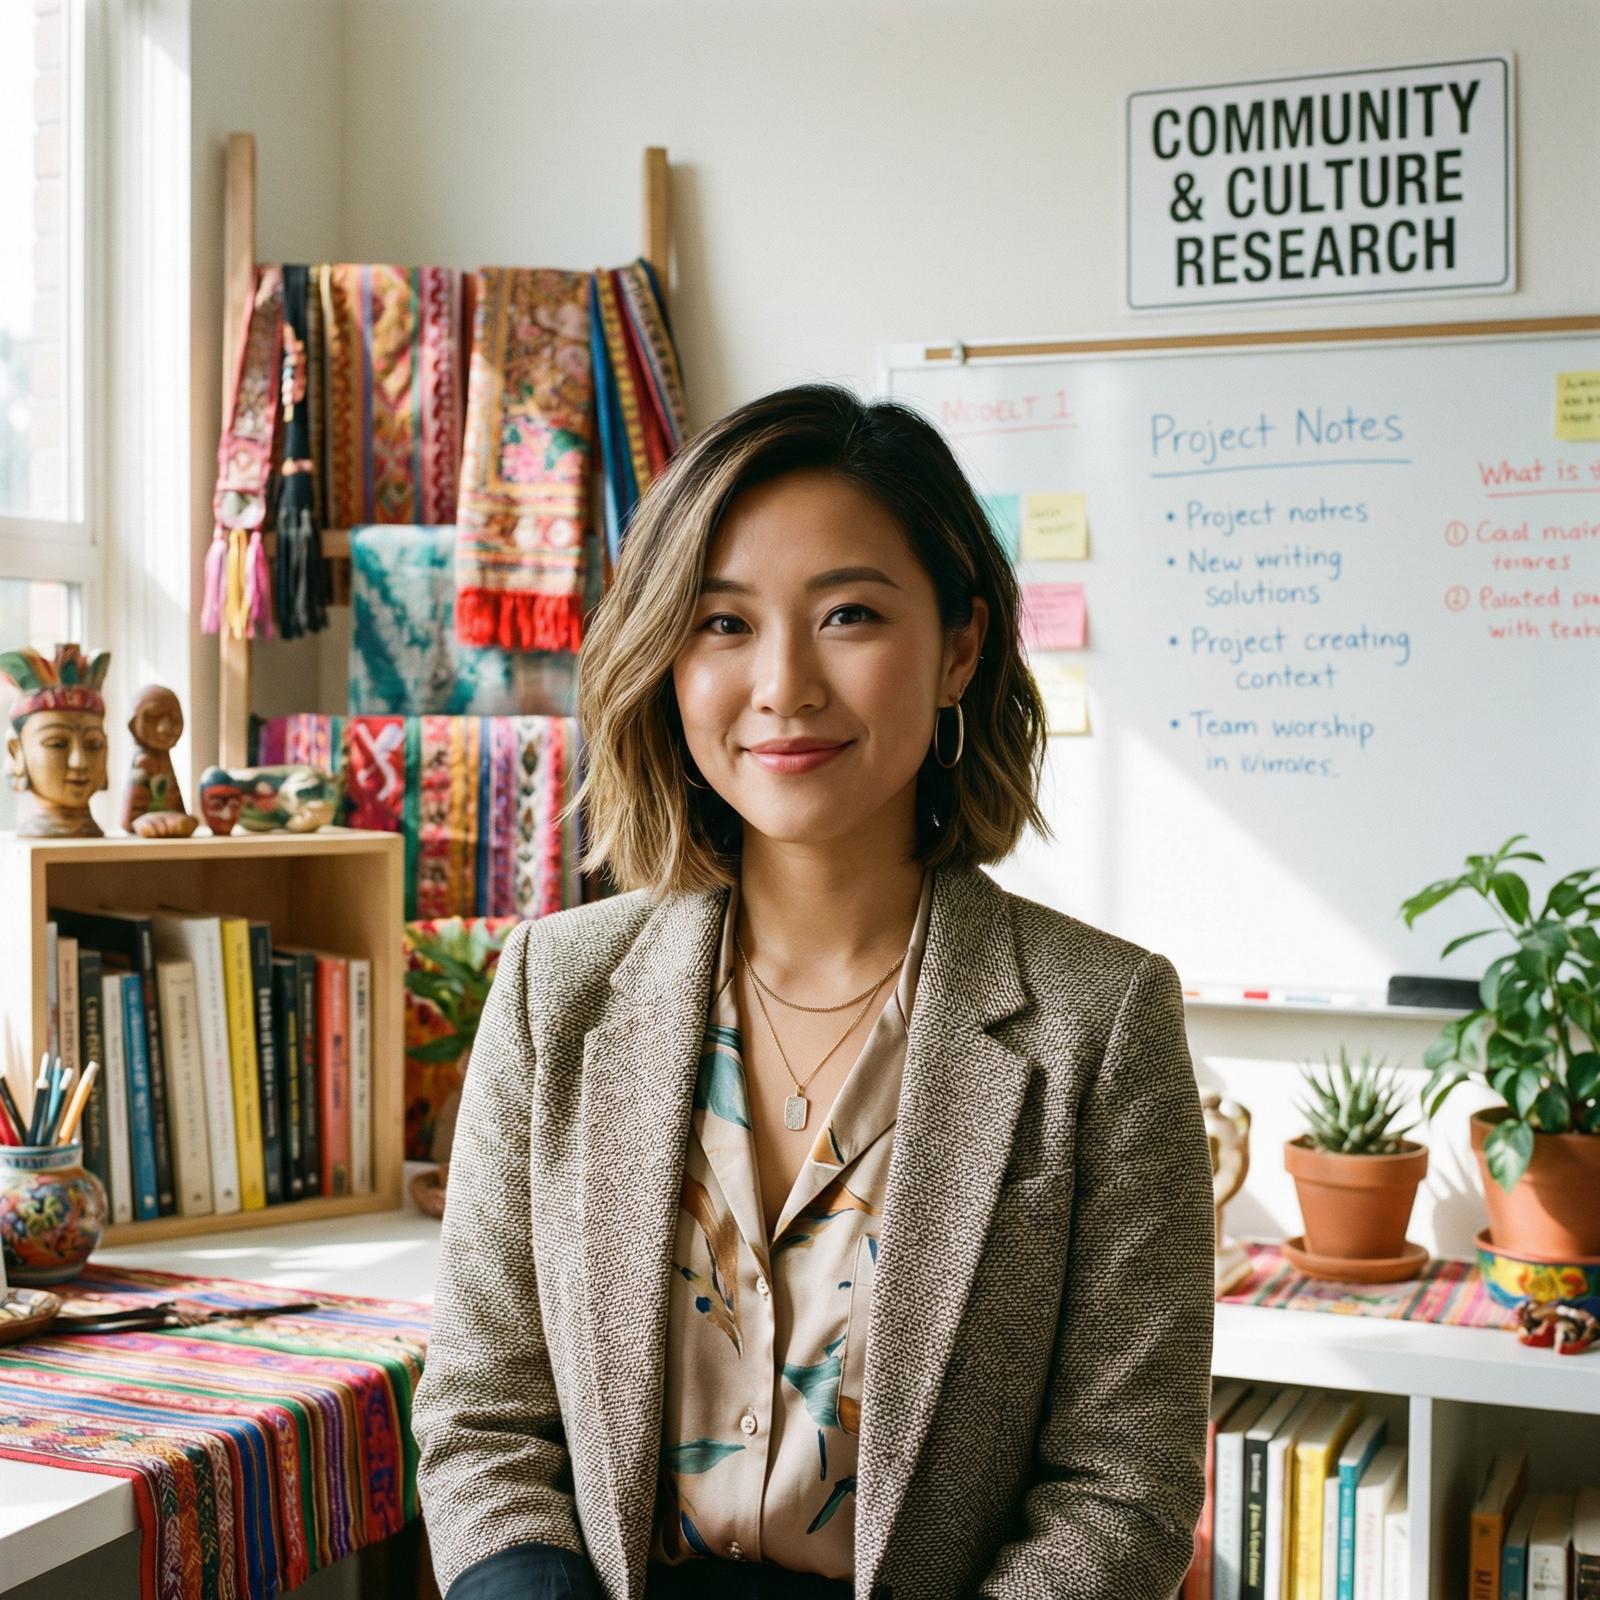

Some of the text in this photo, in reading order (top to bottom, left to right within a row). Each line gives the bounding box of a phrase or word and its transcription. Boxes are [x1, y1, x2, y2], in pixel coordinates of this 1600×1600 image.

[1152, 79, 1480, 160] COMMUNITY
[1170, 149, 1464, 222] & CULTURE
[1175, 216, 1456, 287] RESEARCH
[1150, 407, 1405, 465] Project Notes
[1477, 459, 1545, 487] What
[1557, 459, 1580, 482] is
[1186, 499, 1275, 537] Project
[1187, 549, 1243, 574] New
[1204, 581, 1321, 608] solutions
[1191, 623, 1412, 666] Project creating
[1235, 665, 1338, 690] context
[1190, 709, 1375, 749] Team worship
